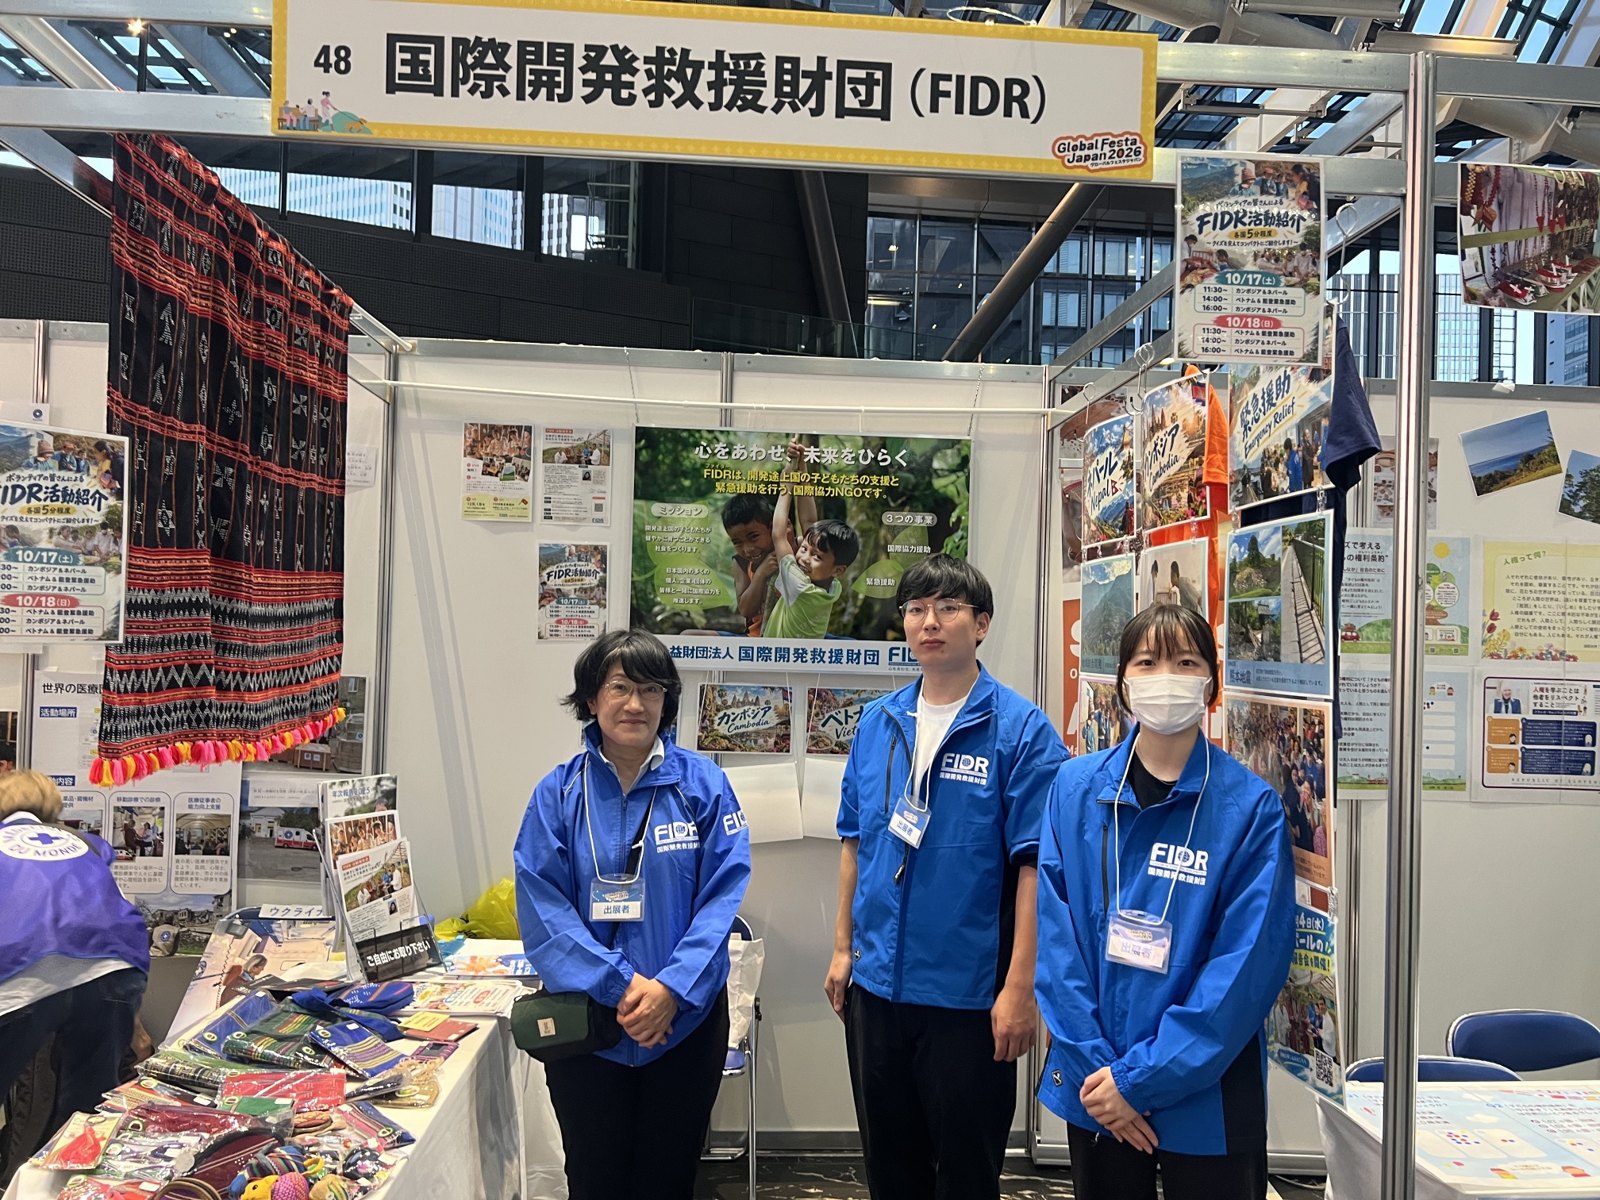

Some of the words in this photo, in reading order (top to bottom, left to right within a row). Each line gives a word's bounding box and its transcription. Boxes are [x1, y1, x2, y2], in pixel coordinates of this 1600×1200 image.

[313, 44, 353, 76] 48
[1057, 138, 1099, 154] Global
[1101, 136, 1138, 152] Festa
[1067, 152, 1107, 164] Japan
[1108, 146, 1142, 160] 2026
[1196, 209, 1307, 235] FIDR活動紹介
[1225, 272, 1276, 286] 10/17(土)
[1226, 317, 1274, 328] 10/18(日)
[1240, 369, 1291, 442] 緊急援助
[1244, 421, 1272, 459] Emergency
[1273, 396, 1295, 428] Relief
[6, 472, 85, 483] ボランティアの皆さんによる
[703, 468, 899, 487] FIDRは、開発途上国の子どもたちの支援と
[0, 482, 109, 512] IDR活動紹介
[715, 482, 888, 499] 緊急援助を行う、国際協力NGOです。
[27, 504, 71, 515] 各国5分程度
[659, 506, 703, 517] ミッション
[16, 550, 73, 564] 10/17(土)
[16, 595, 71, 607] 10/18(日)
[738, 645, 880, 666] 国際開発救援財団
[42, 683, 103, 694] 世界の医療
[40, 707, 76, 717] 活動場所
[717, 706, 772, 727] カンボジア
[727, 718, 770, 734] Cambodia
[942, 752, 990, 774] FIDR
[1150, 842, 1209, 872] FIDR
[603, 905, 631, 915] 出展者
[366, 939, 431, 967] ご自由にお取り下さい
